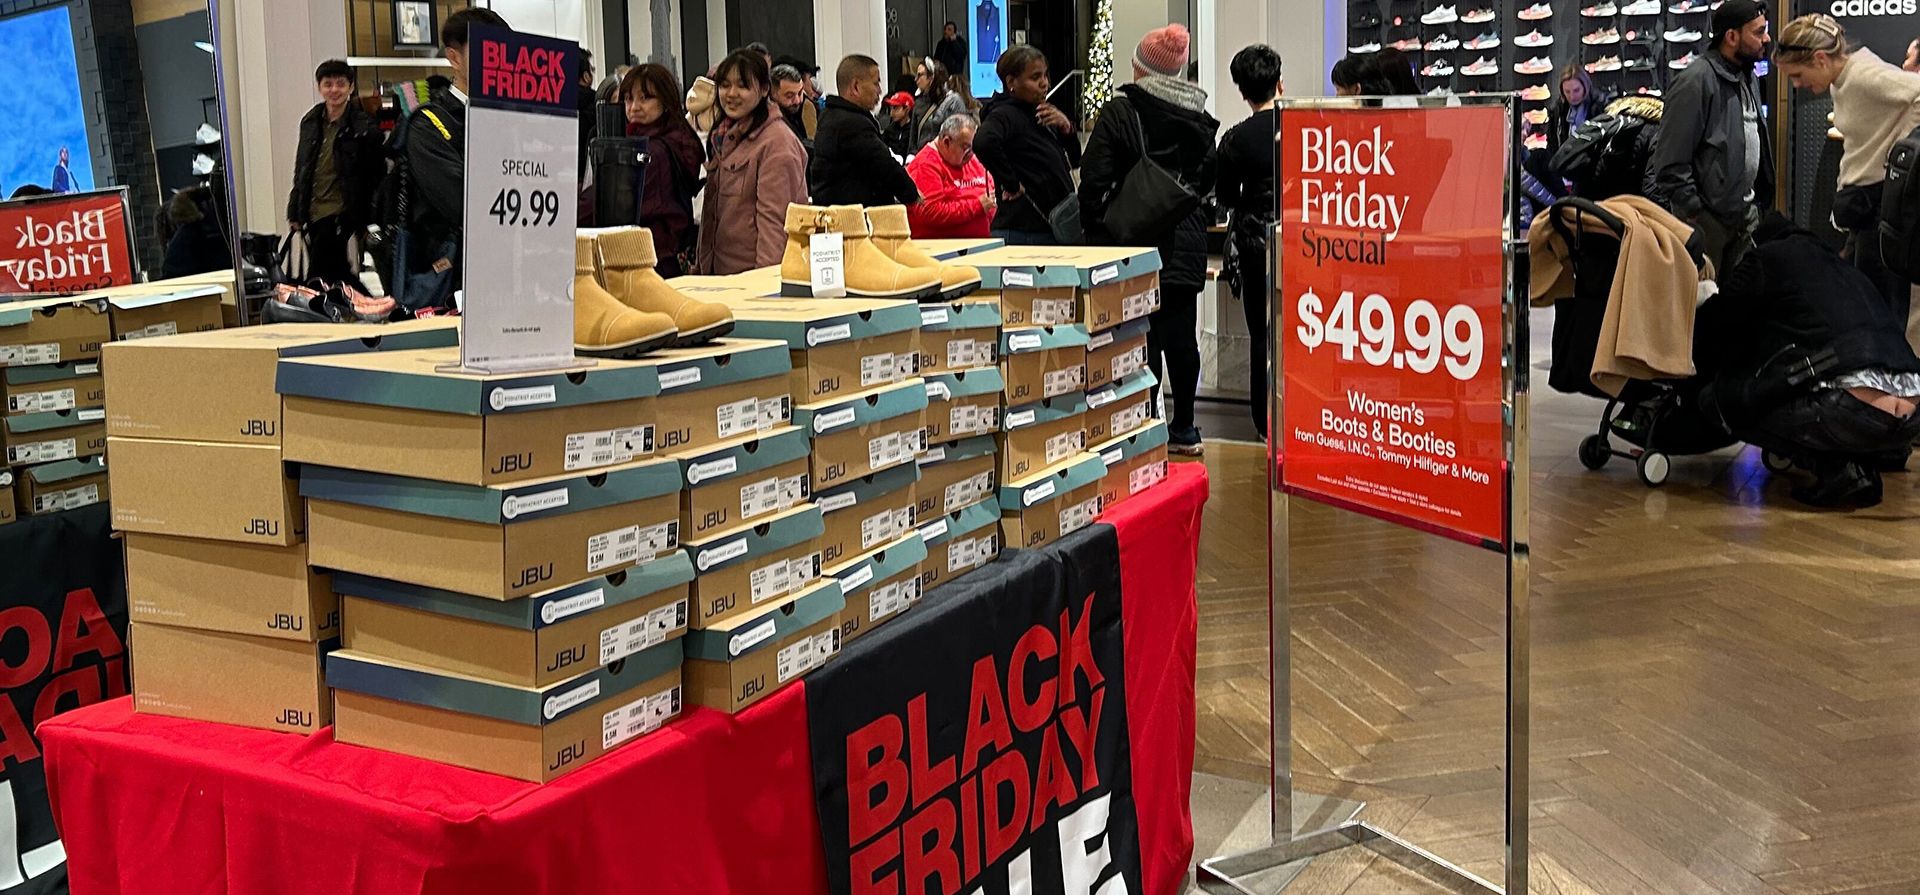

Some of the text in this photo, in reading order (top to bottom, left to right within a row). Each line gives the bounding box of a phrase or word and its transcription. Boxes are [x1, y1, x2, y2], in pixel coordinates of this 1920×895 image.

[1830, 0, 1917, 17] adidas
[482, 40, 565, 79] BLACK
[482, 69, 565, 104] FRIDAY
[1301, 125, 1395, 176] Black
[502, 159, 548, 178] SPECIAL
[489, 188, 559, 228] 49.99
[1301, 178, 1410, 242] Friday
[1302, 227, 1386, 267] Special
[1005, 311, 1024, 323] JBU
[1094, 311, 1110, 327] JBU
[1297, 286, 1484, 380] $49.99
[813, 376, 840, 395] JBU
[1090, 368, 1105, 384] JBU
[1011, 384, 1029, 399] JBU
[1347, 389, 1425, 426] Women's
[240, 420, 275, 436] JBU
[657, 427, 691, 449] JBU
[926, 424, 940, 437] BU
[1088, 424, 1104, 439] JBU
[1321, 408, 1456, 459] Boots & Booties
[491, 452, 532, 475] JBU
[1295, 427, 1315, 443] from
[1316, 434, 1346, 454] Guess,
[1377, 447, 1411, 469] Tommy
[1413, 456, 1449, 476] Hilfiger
[1452, 462, 1459, 478] &
[1462, 465, 1489, 485] More
[820, 461, 846, 482] JBU
[1012, 460, 1030, 476] JBU
[244, 518, 278, 536] JBU
[697, 508, 727, 532] JBU
[1027, 528, 1046, 547] JBU
[511, 563, 553, 589] JBU
[704, 592, 736, 618] JBU
[267, 613, 303, 631] JBU
[547, 644, 586, 673] JBU
[736, 674, 765, 703] JBU
[276, 709, 313, 728] JBU
[846, 591, 1105, 849] BLACK
[549, 740, 585, 771] JBU
[850, 685, 1105, 895] FRIDAY
